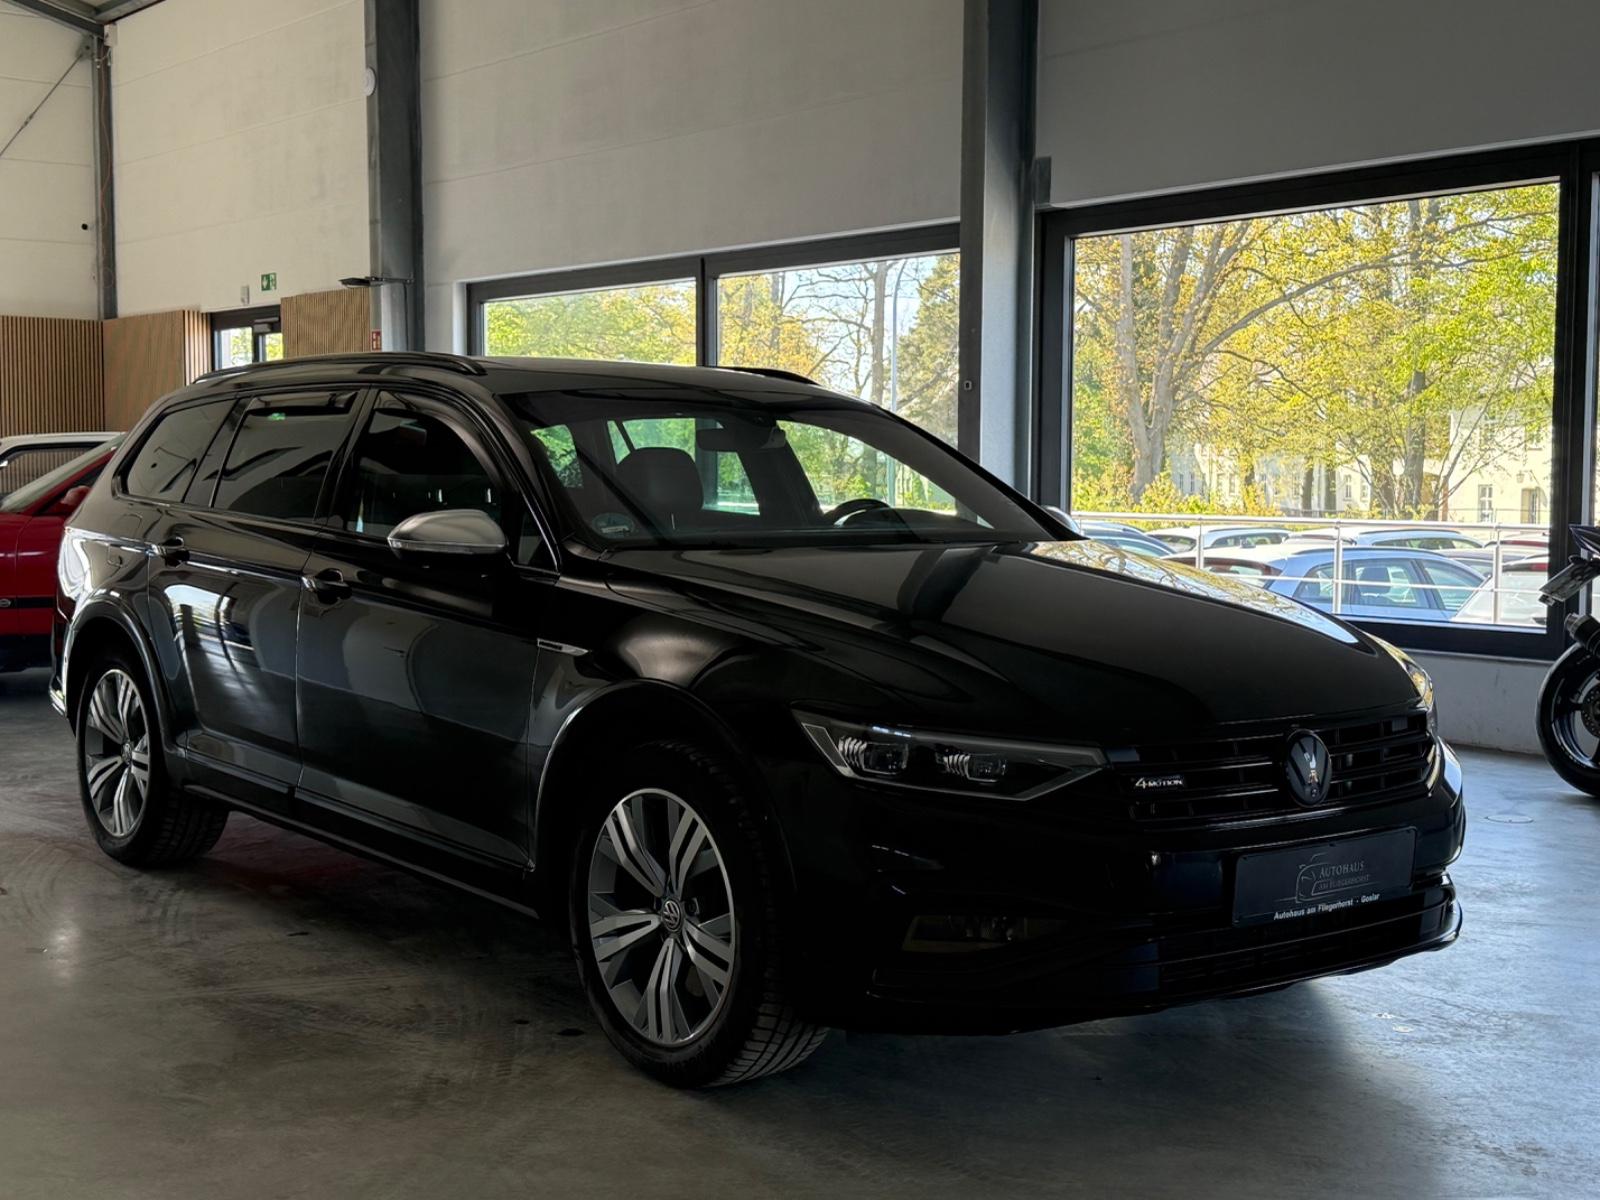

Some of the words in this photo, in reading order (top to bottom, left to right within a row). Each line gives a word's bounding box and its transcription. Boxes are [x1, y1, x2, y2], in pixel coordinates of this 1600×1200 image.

[1319, 861, 1365, 878] AUTOHAUS
[1273, 908, 1305, 920] Autohaus
[1306, 906, 1317, 915] am
[1360, 892, 1381, 904] Goslar
